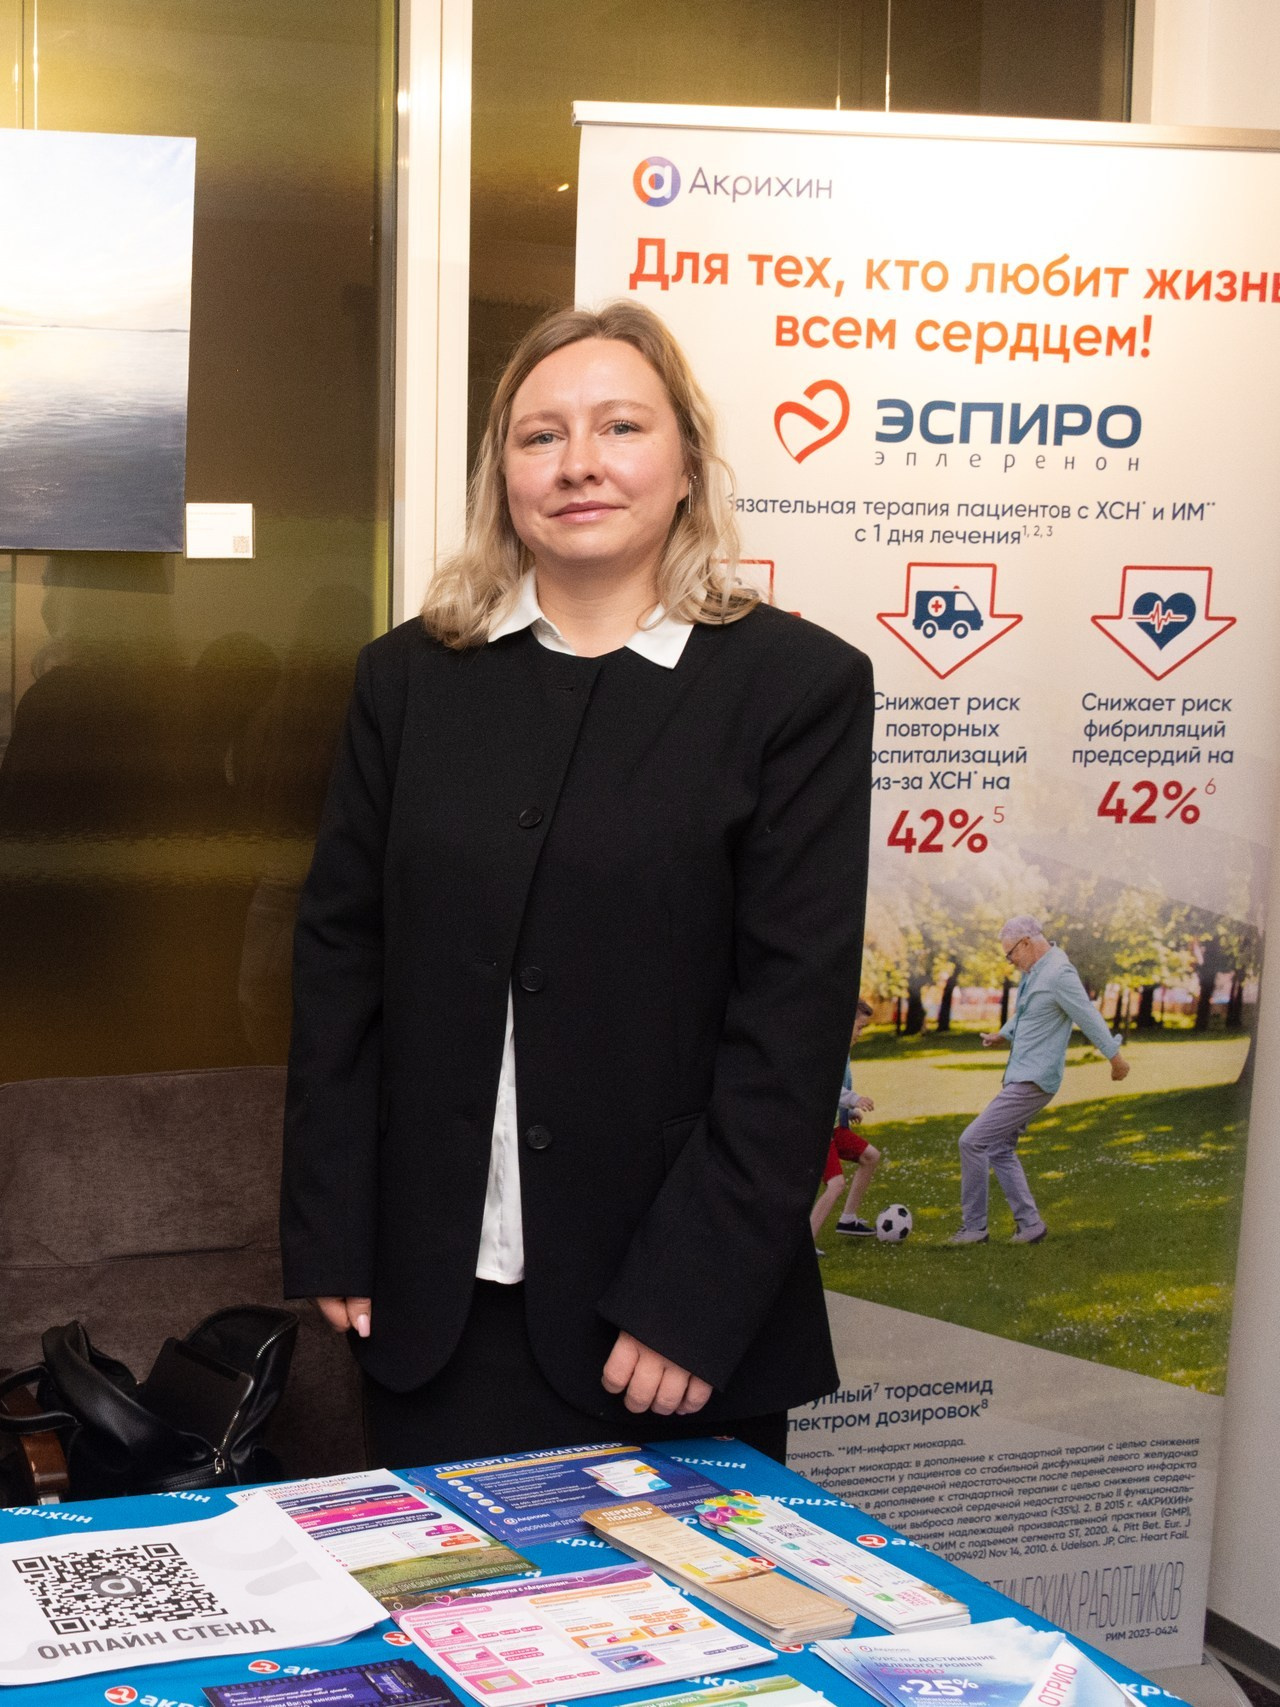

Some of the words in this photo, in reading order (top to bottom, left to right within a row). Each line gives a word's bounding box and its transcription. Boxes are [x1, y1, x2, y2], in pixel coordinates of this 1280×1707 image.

[688, 166, 833, 203] Акрихин
[629, 237, 729, 291] Для
[747, 253, 845, 298] тех,
[865, 258, 949, 293] кто
[965, 253, 1129, 298] любит
[775, 314, 897, 350] всем
[915, 314, 1153, 365] сердцем!
[875, 398, 1142, 449] ЭСПИРО
[874, 451, 1140, 473] эплеренон
[730, 497, 856, 515] язательная
[863, 500, 949, 520] терапия
[956, 502, 1071, 520] пациентов
[1077, 505, 1090, 520] с
[1152, 507, 1165, 521] и
[854, 527, 867, 543] с
[873, 523, 881, 542] 1
[887, 528, 924, 546] дня
[874, 691, 961, 711] Снижает
[967, 696, 1021, 715] риск
[1081, 692, 1176, 712] Снижает
[1181, 697, 1233, 717] риск
[886, 723, 1000, 742] повторных
[1083, 719, 1226, 742] фибрилляций
[1072, 746, 1201, 768] предсердий
[1208, 749, 1234, 764] на
[871, 775, 923, 791] из-за
[982, 775, 1010, 790] на
[1097, 780, 1201, 825] 42%
[887, 808, 988, 853] 42%
[885, 1379, 993, 1401] торасемид
[787, 1412, 870, 1433] пектром
[434, 1456, 516, 1473] ГРЕЛОРТА
[527, 1442, 623, 1460] ТИКАГРЕЛОР
[810, 1466, 856, 1479] Инфаркт
[859, 1460, 912, 1473] миокарда:
[923, 1455, 986, 1468] дополнение
[997, 1446, 1063, 1463] стандартной
[1065, 1443, 1105, 1455] терапии
[1116, 1439, 1147, 1450] целью
[1150, 1437, 1200, 1447] снижения
[913, 1438, 966, 1450] миокарда.
[834, 1488, 889, 1500] ризнаками
[891, 1480, 947, 1494] сердечной
[949, 1475, 1037, 1489] недостаточности
[1039, 1472, 1068, 1482] после
[1070, 1464, 1144, 1478] перенесенного
[1146, 1461, 1197, 1473] инфаркта
[897, 1473, 905, 1484] у
[907, 1467, 962, 1480] пациентов
[964, 1466, 977, 1475] со
[980, 1461, 1039, 1475] стабильной
[1041, 1455, 1105, 1470] дисфункцией
[1107, 1452, 1140, 1463] левого
[1143, 1450, 1199, 1461] желудочка
[873, 1495, 935, 1510] дополнение
[947, 1487, 1014, 1502] стандартной
[1017, 1484, 1059, 1497] терапии
[1070, 1480, 1101, 1491] целью
[1103, 1475, 1150, 1487] снижения
[1153, 1473, 1195, 1484] сердеч-
[898, 1504, 963, 1520] хронической
[965, 1499, 1021, 1513] сердечной
[1023, 1491, 1114, 1507] недостаточностью
[1123, 1486, 1195, 1498] функциональ-
[909, 1518, 954, 1530] выброса
[956, 1515, 992, 1525] левого
[994, 1509, 1048, 1522] желудочка
[1104, 1500, 1125, 1511] 2015
[948, 1524, 1014, 1538] надлежащей
[1018, 1513, 1108, 1533] производственной
[1111, 1510, 1157, 1522] практики
[932, 1541, 956, 1551] ОИМ
[967, 1536, 1018, 1550] подъемом
[1020, 1532, 1066, 1546] сегмента
[988, 1548, 1008, 1559] Nov
[1140, 1532, 1168, 1543] Heart
[1077, 1561, 1185, 1631] РАБОТНИКОВ
[37, 1630, 168, 1660] ОНЛАЙН
[172, 1618, 277, 1641] СТЕНД
[1105, 1631, 1126, 1642] РИМ
[1038, 1663, 1078, 1707] ОТРИО
